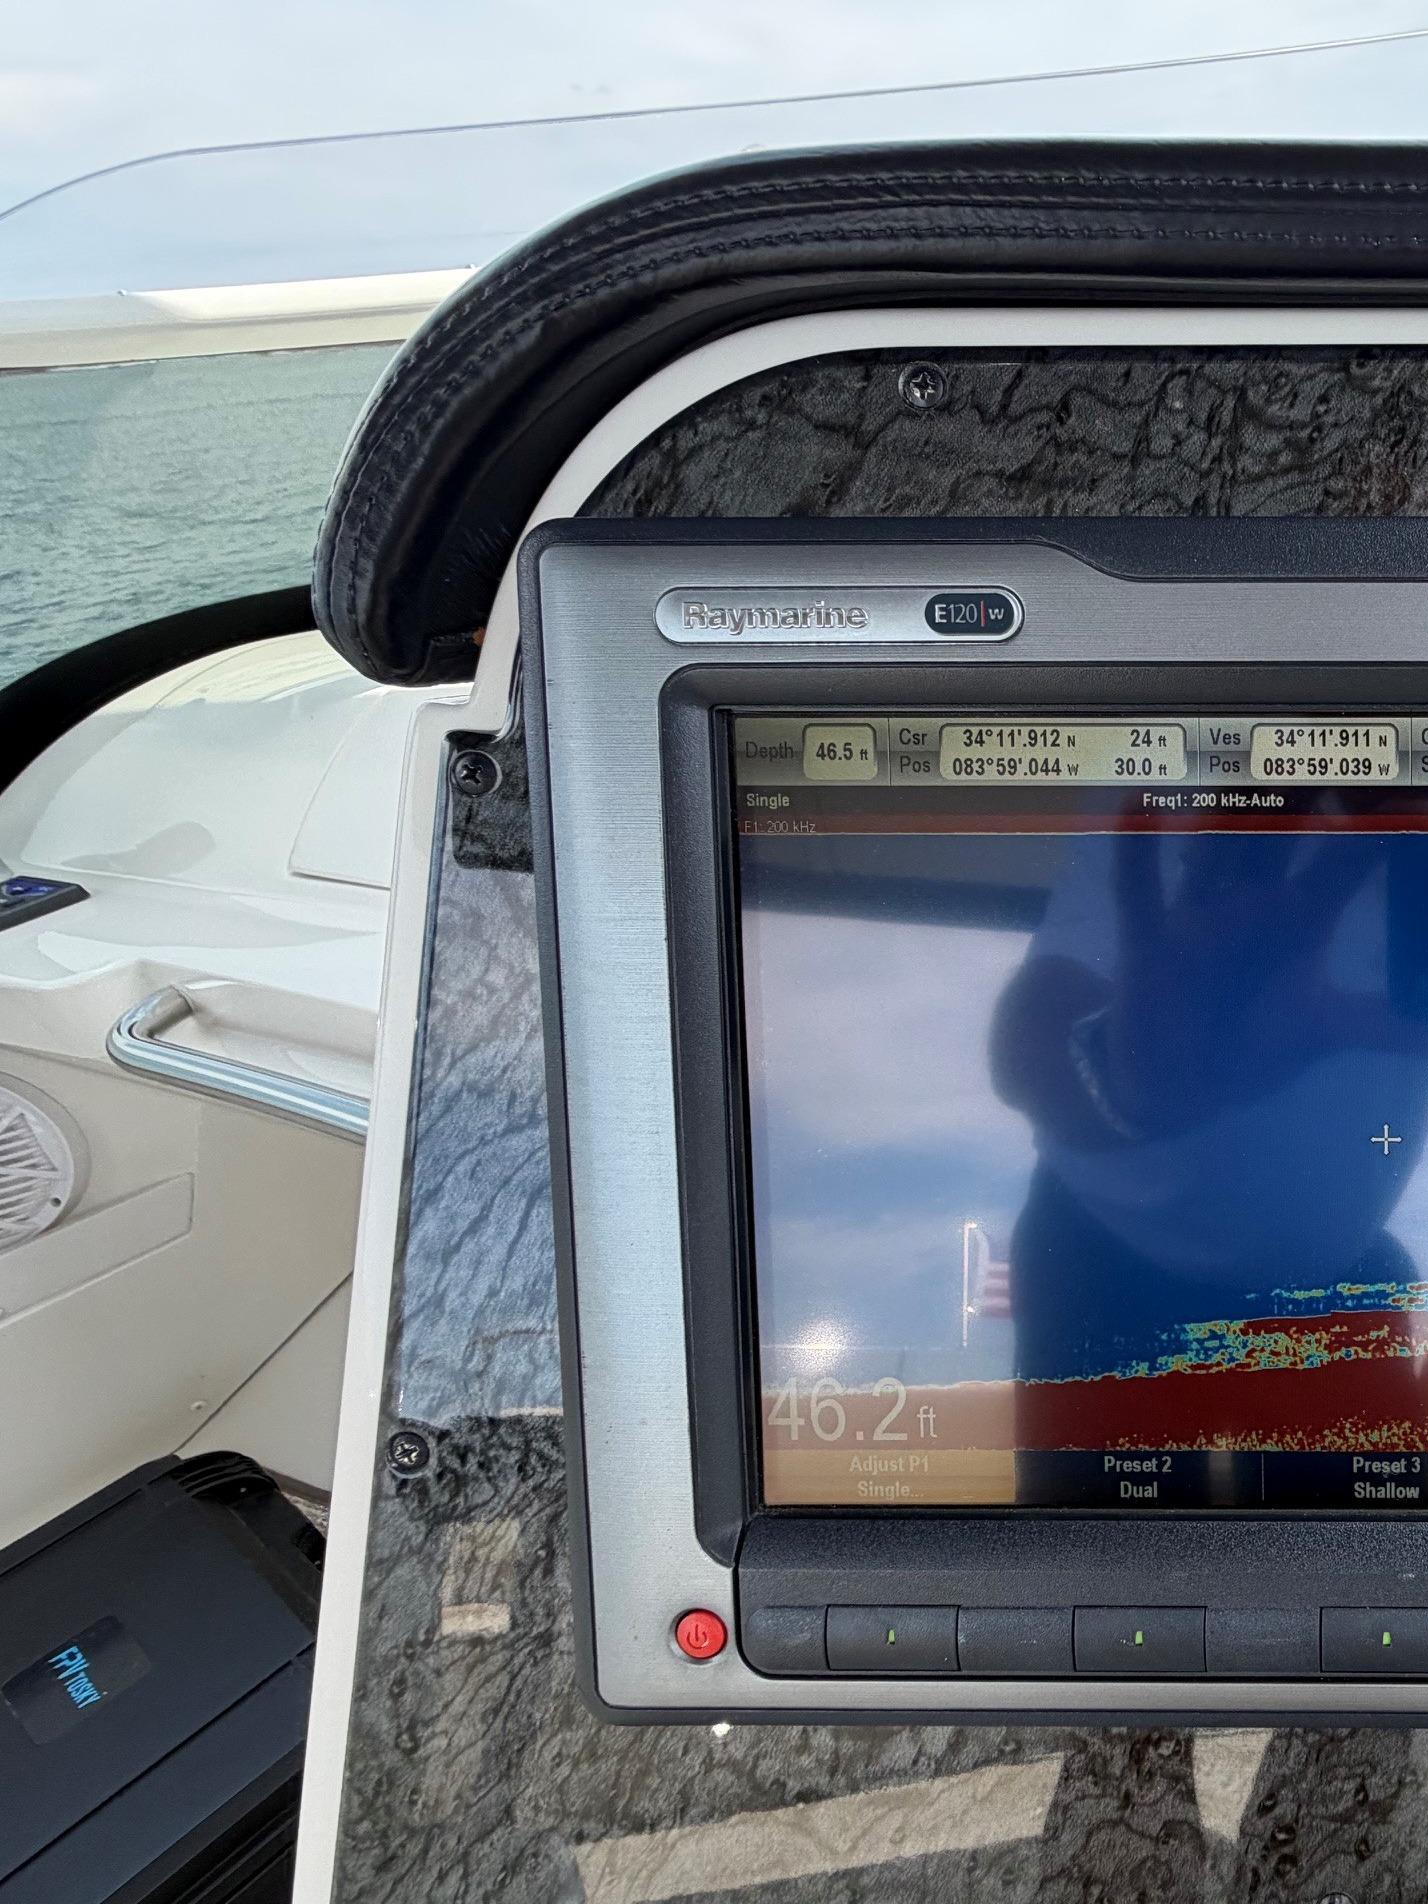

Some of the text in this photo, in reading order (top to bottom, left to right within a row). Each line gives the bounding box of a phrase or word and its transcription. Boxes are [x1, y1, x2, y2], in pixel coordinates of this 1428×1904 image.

[682, 600, 870, 636] Raymarine
[899, 727, 929, 746] Csr
[1067, 734, 1077, 748] N
[1130, 728, 1153, 748] 24
[1158, 734, 1168, 748] ft
[1209, 727, 1241, 746] Ves
[1379, 734, 1387, 748] N
[744, 741, 869, 765] Depth 46.5 ft
[899, 755, 932, 774] Pos
[1067, 763, 1079, 776] W
[1114, 757, 1152, 777] 30.0
[1158, 763, 1168, 776] ft
[1209, 756, 1241, 774] Pos
[1378, 763, 1390, 776] W
[746, 793, 790, 809] Single
[1143, 793, 1285, 810] Freq1: 200 kHz-Auto
[767, 820, 789, 833] 200
[793, 820, 817, 833] kHz
[767, 1376, 938, 1442] 46.2 ft
[850, 1455, 930, 1475] Adjust P1
[1104, 1456, 1172, 1473] Preset 2
[1353, 1456, 1421, 1474] Preset 3
[1120, 1481, 1158, 1498] Dual
[1354, 1482, 1420, 1499] Shallow
